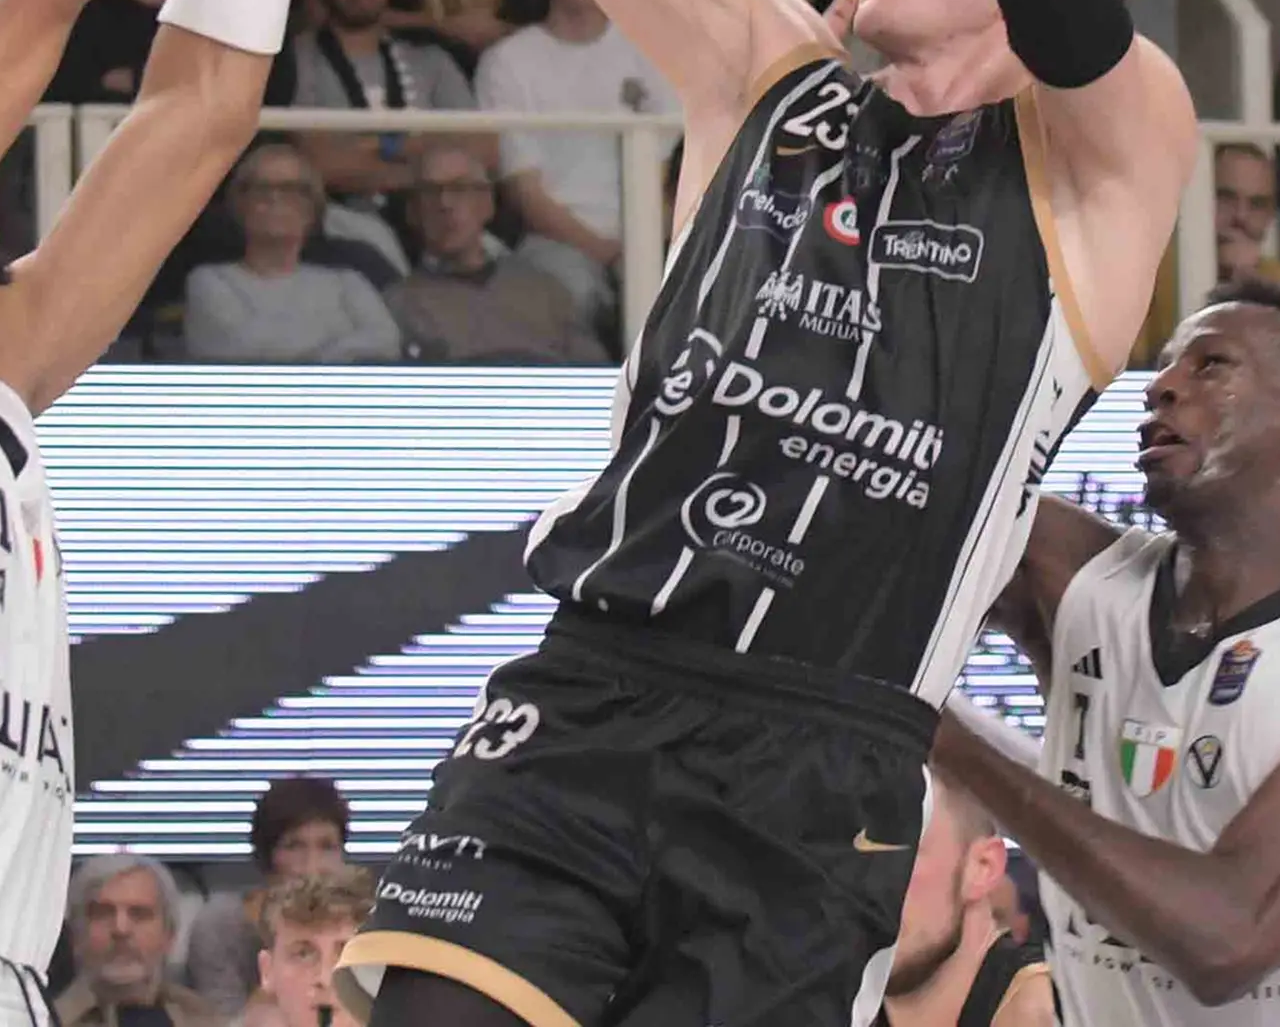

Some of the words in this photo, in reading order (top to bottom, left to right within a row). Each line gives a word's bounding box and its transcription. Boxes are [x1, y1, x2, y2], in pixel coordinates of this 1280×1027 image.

[883, 232, 971, 266] TRENTINO
[804, 279, 883, 332] ITAS
[798, 312, 861, 342] MUTUA
[712, 360, 945, 471] Dolomiti
[778, 435, 932, 509] energia
[380, 882, 484, 911] Dolomiti
[407, 906, 475, 924] energia
